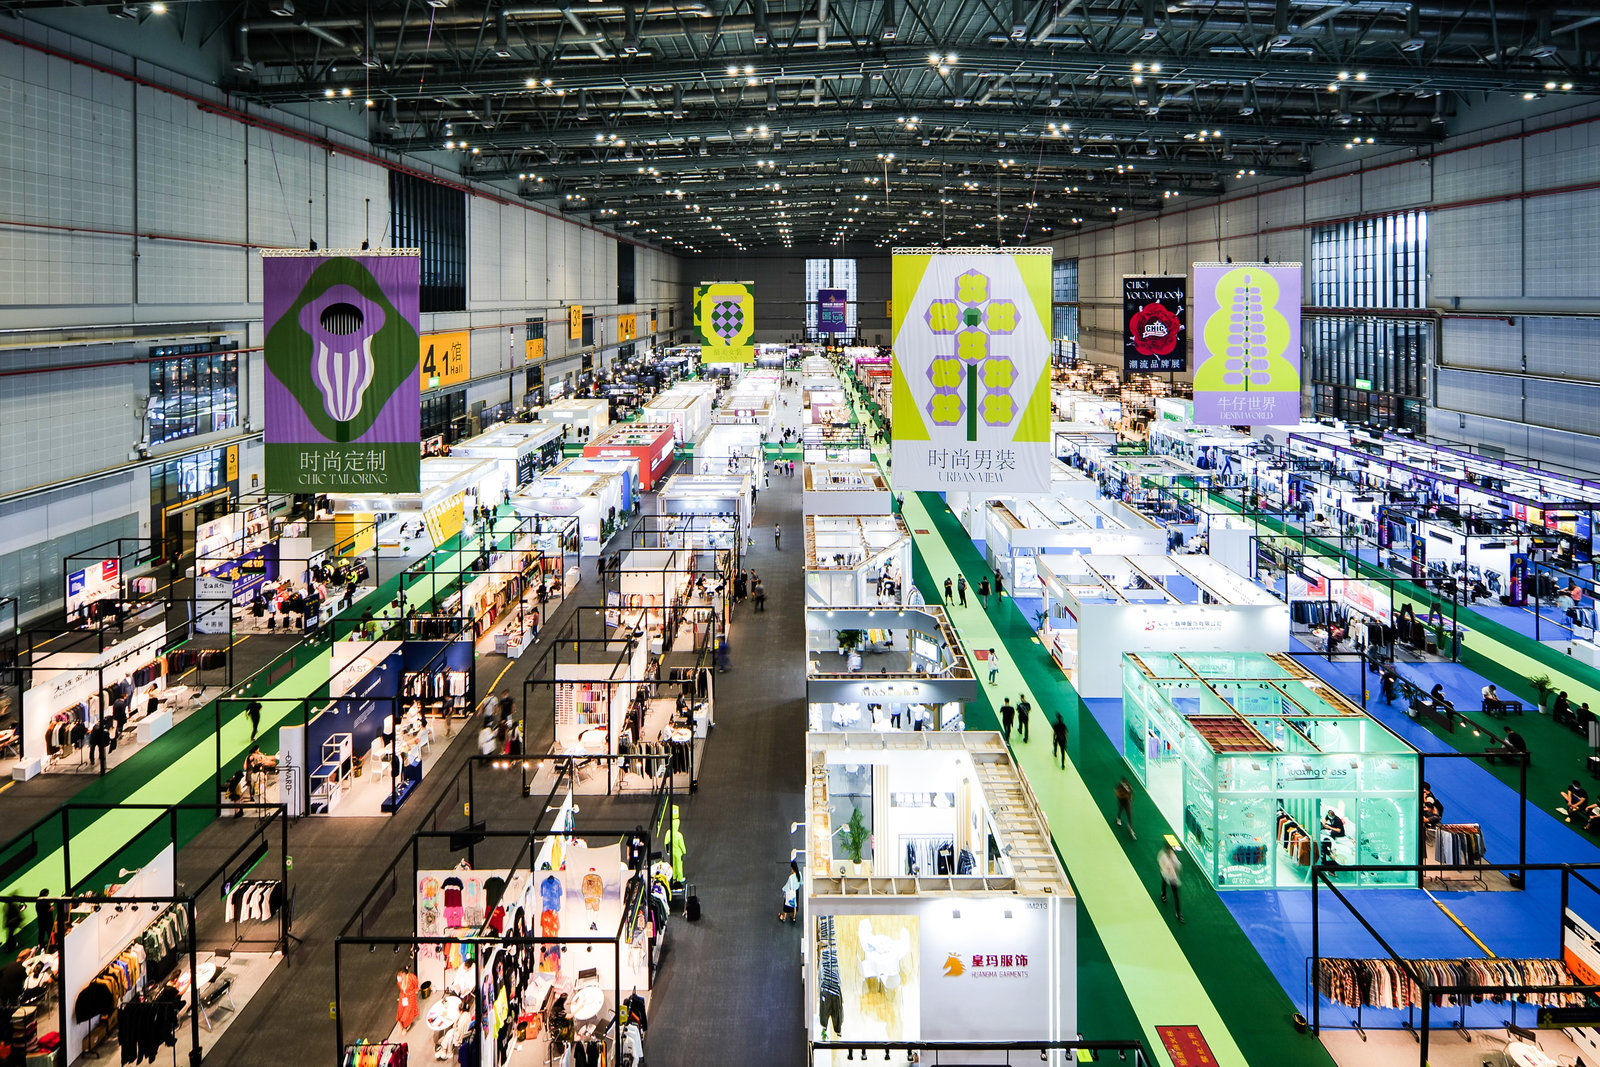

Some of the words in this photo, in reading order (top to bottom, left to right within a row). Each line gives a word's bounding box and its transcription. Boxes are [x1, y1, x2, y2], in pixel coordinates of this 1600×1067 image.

[1126, 281, 1146, 289] CHIC
[1126, 291, 1154, 300] YOUNG
[1155, 291, 1184, 300] BLOOD
[1145, 324, 1165, 332] CHIC
[423, 344, 449, 378] 4.1
[451, 341, 462, 363] 馆
[1129, 359, 1181, 369] 潮流品牌展
[450, 364, 463, 375] Hall
[1216, 396, 1276, 411] 牛仔世界
[1220, 411, 1244, 420] DENIM
[1244, 411, 1274, 420] WORLD
[229, 453, 235, 463] 3
[300, 450, 386, 472] 时尚定制
[928, 448, 1016, 470] 时尚男装
[298, 474, 327, 485] CHIC
[329, 474, 388, 485] TAILORING
[938, 472, 977, 483] URBAN
[978, 472, 1005, 483] VIEW
[285, 754, 293, 792] ONWARD
[1285, 767, 1320, 777] uaxing
[1322, 767, 1347, 776] dess
[971, 954, 1029, 967] 皇玛服饰
